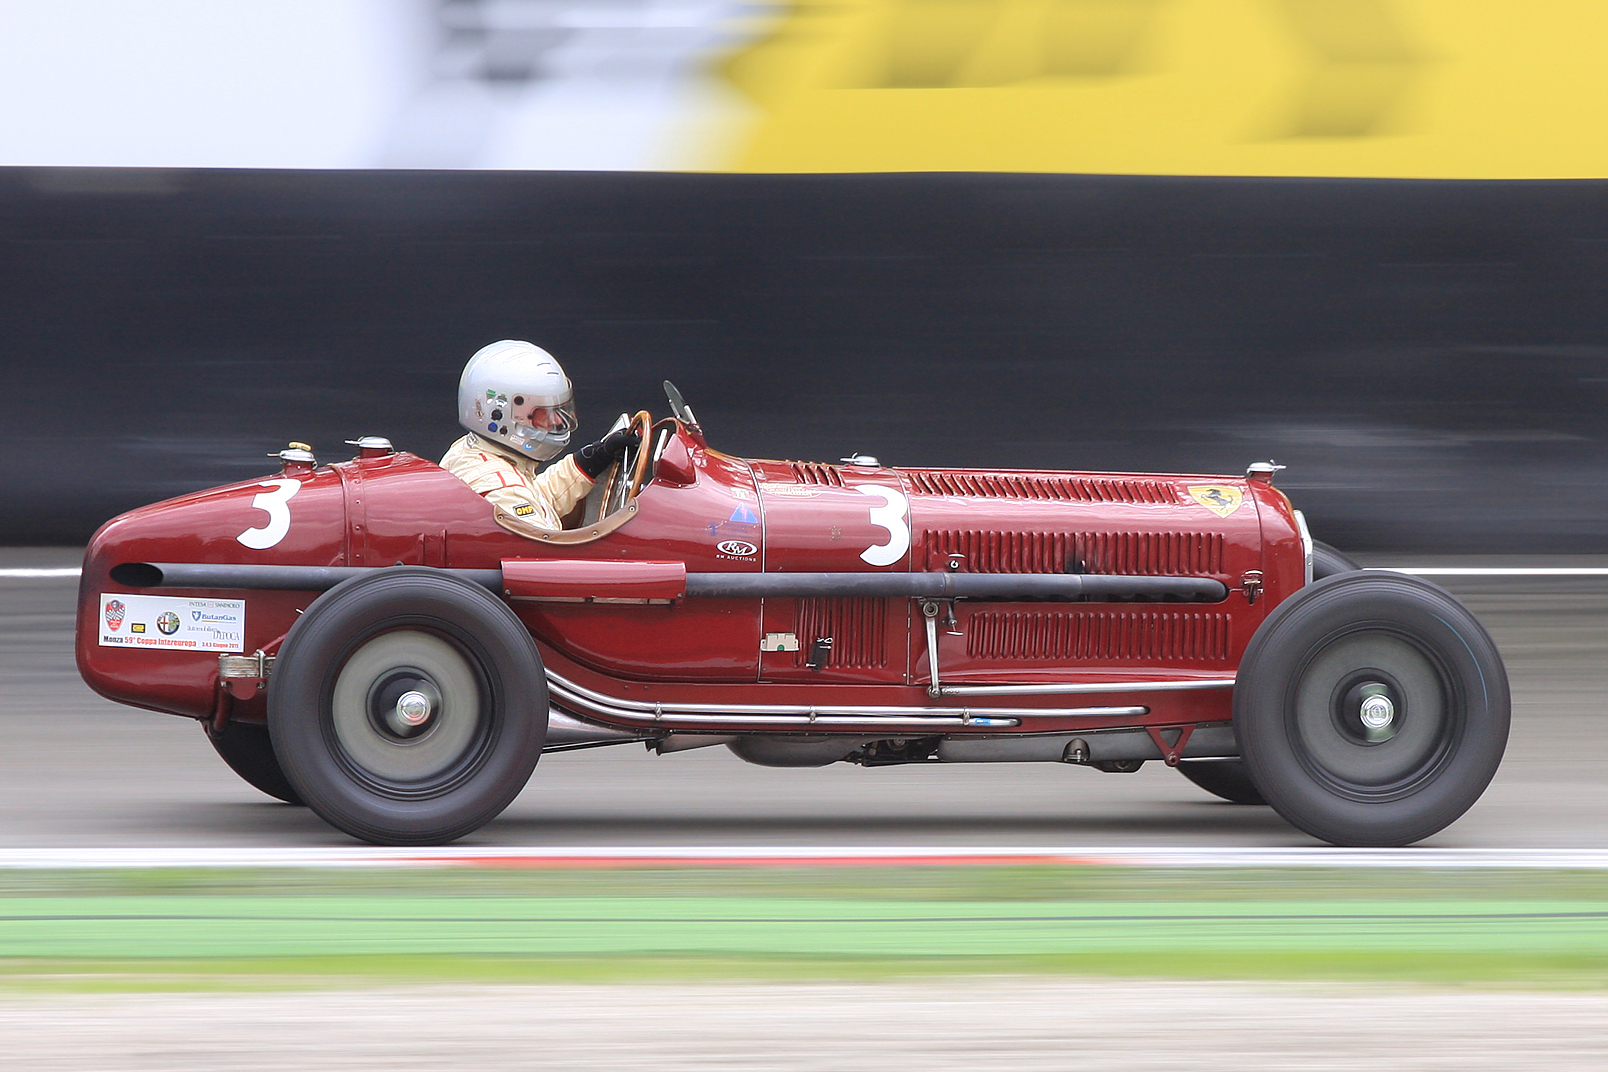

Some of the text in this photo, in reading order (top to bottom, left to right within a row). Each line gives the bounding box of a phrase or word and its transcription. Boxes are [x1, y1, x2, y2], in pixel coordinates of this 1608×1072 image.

[236, 478, 302, 550] 3
[516, 505, 533, 515] OMP
[853, 484, 910, 566] 3
[202, 613, 237, 621] ButanGas
[103, 635, 123, 643] Monza
[137, 637, 157, 645] Coppa
[159, 638, 197, 647] Intereuropa
